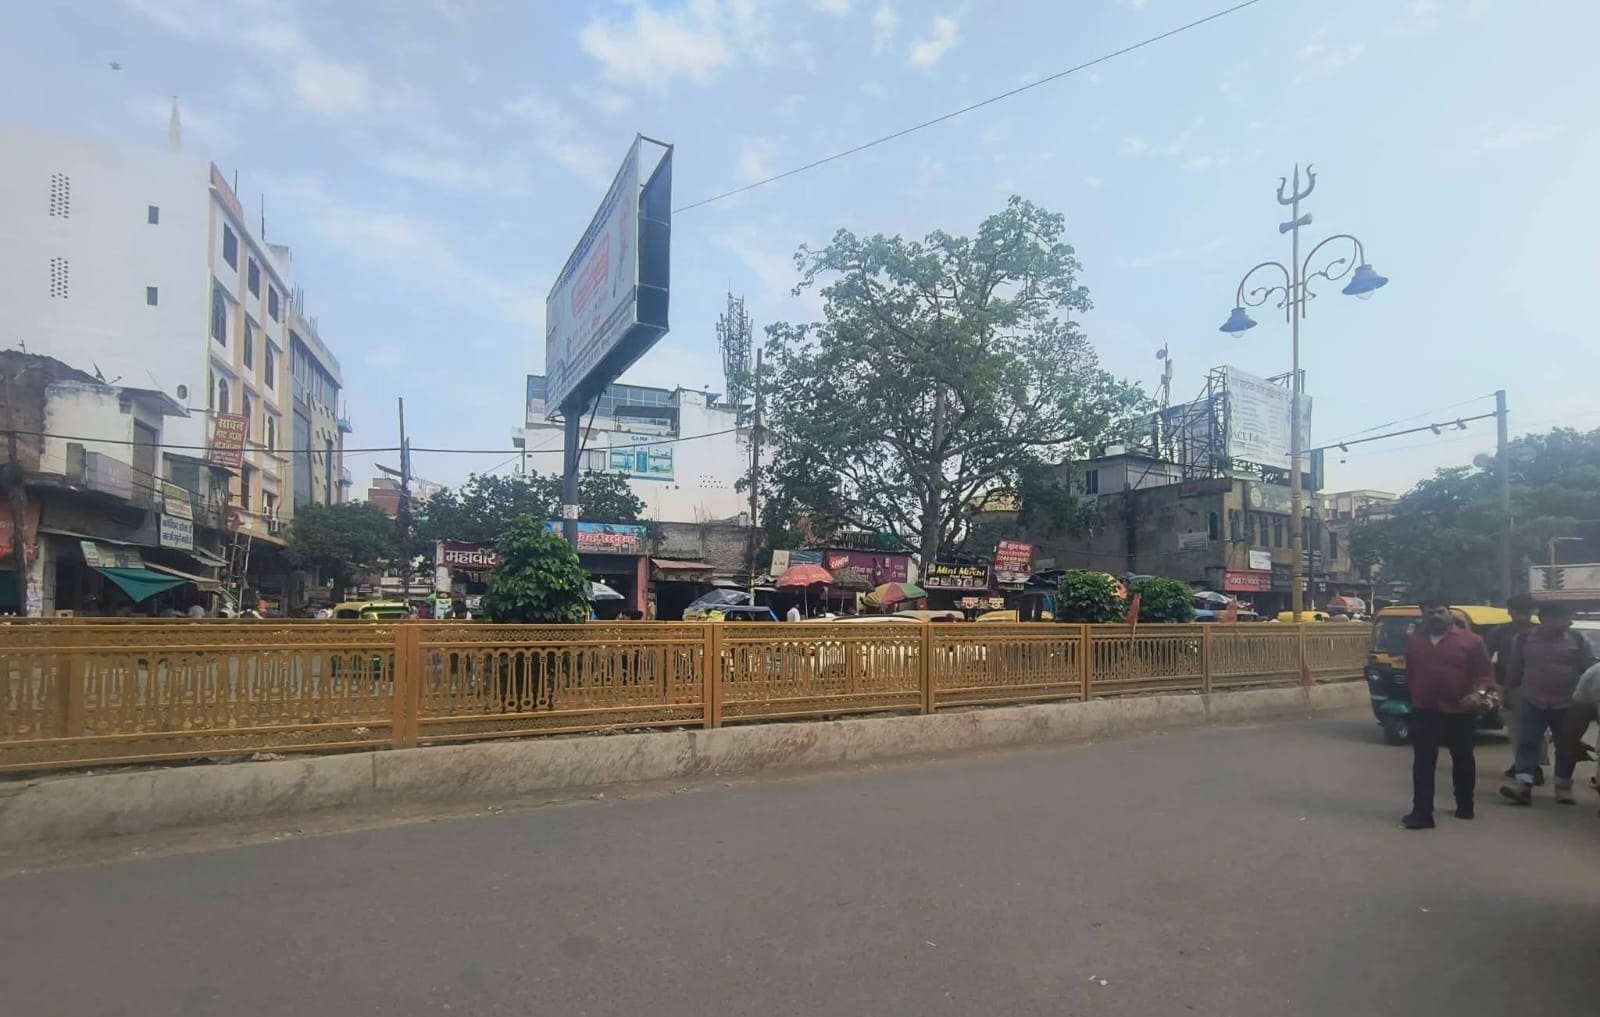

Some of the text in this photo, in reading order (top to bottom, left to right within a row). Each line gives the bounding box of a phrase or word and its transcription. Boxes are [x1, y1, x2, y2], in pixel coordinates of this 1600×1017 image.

[445, 547, 497, 565] महावीर
[936, 565, 957, 575] Mini
[958, 567, 985, 577] Mirchi
